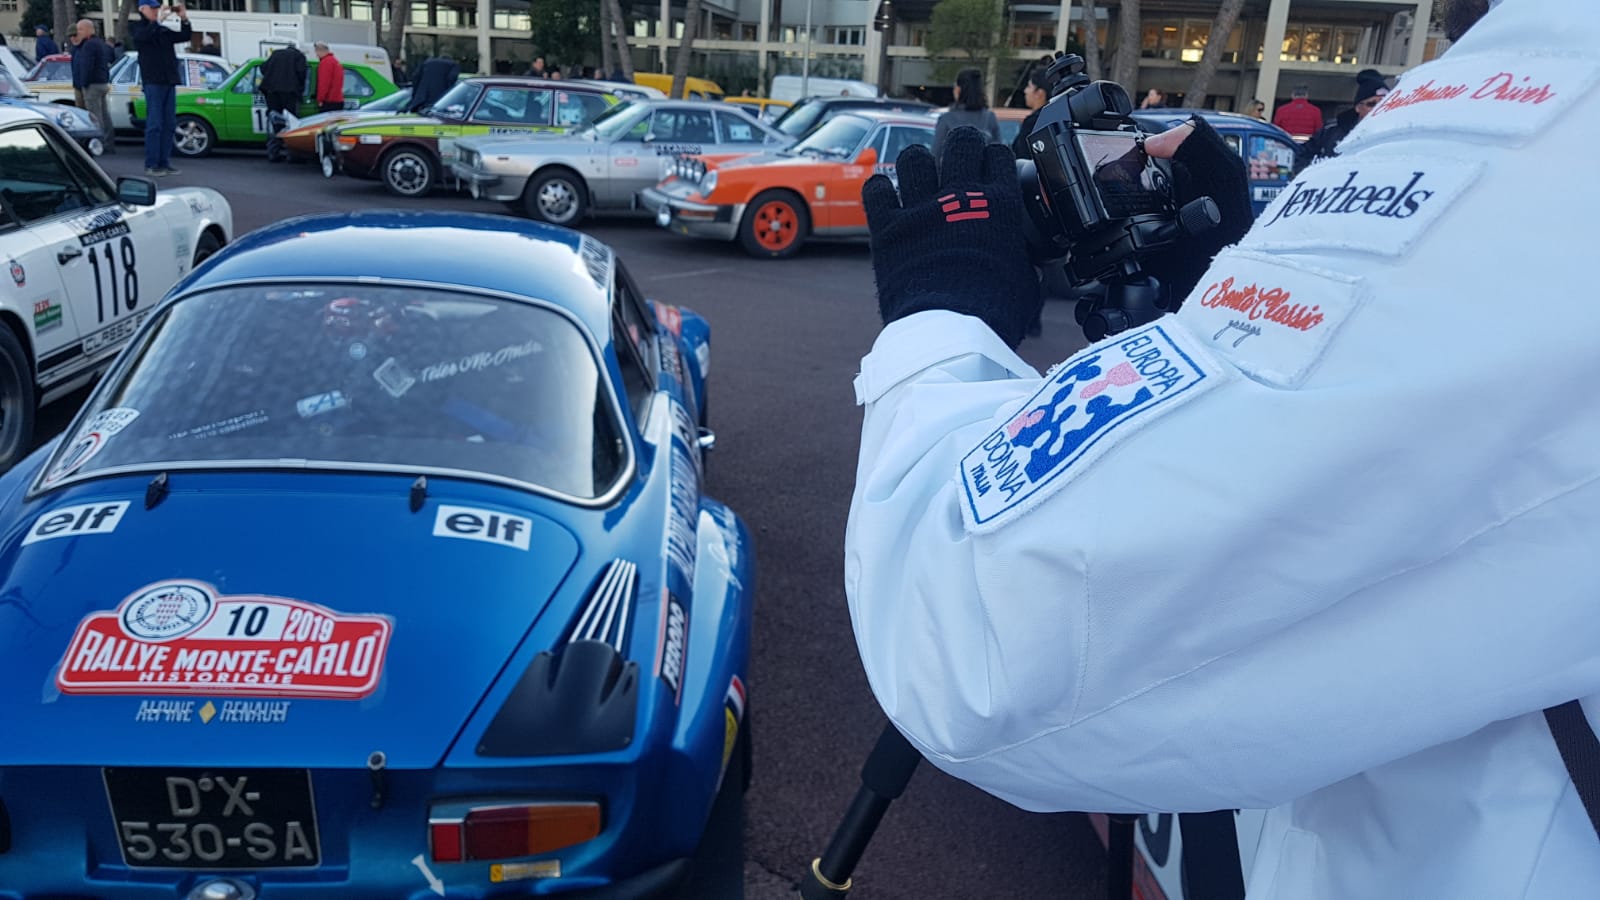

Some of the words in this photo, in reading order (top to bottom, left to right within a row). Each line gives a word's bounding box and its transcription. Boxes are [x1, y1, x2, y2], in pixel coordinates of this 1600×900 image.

[1470, 72, 1557, 104] Driver
[1264, 171, 1435, 227] Jewheels
[88, 236, 138, 323] 118
[1121, 335, 1185, 395] EUROPA
[970, 463, 992, 497] ITALIA
[983, 431, 1027, 502] DONNA
[35, 504, 120, 536] elf
[444, 513, 525, 544] elf
[227, 605, 269, 636] 10
[282, 607, 335, 643] 2019
[71, 629, 171, 672] RALLYE
[172, 635, 377, 677] MONTE-CARLO
[662, 601, 685, 693] FERODO
[138, 672, 294, 685] HISTORIQUE
[135, 700, 195, 722] ALPINE
[219, 700, 291, 722] RENAULT
[120, 820, 314, 862] 530-SA
